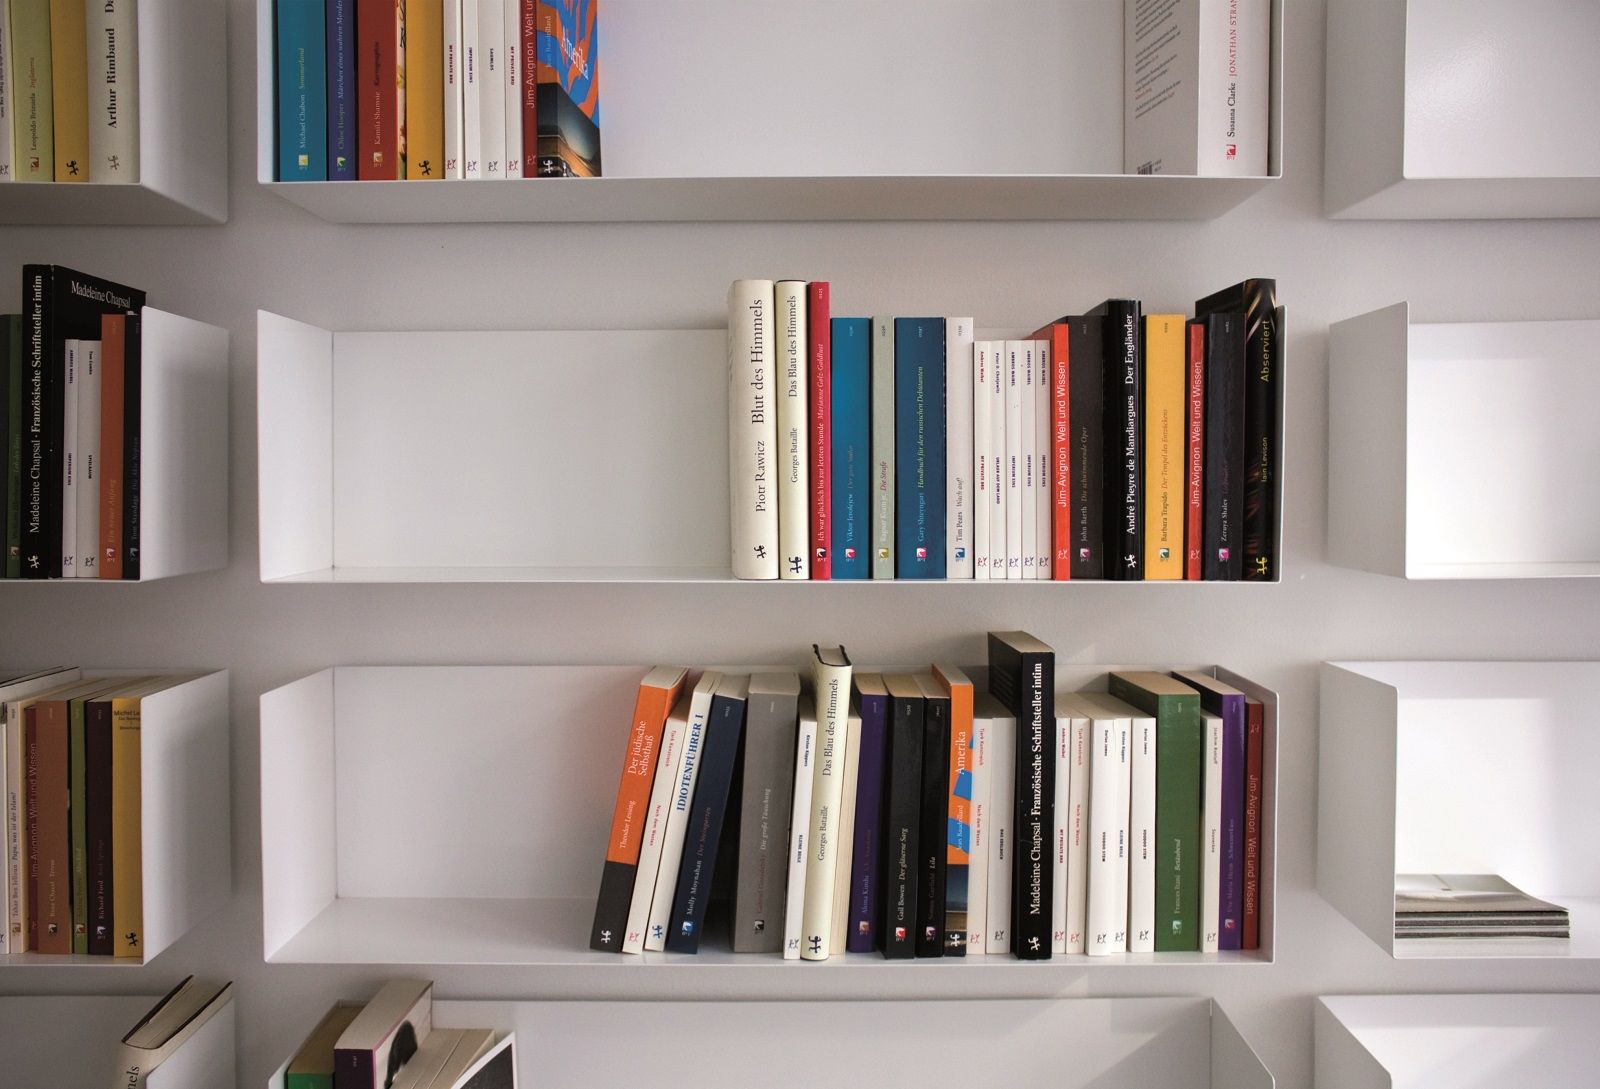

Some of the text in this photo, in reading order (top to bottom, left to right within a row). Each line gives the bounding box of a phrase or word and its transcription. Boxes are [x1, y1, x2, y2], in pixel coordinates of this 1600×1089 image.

[525, 13, 533, 36] Welt
[105, 28, 115, 84] Rimbaud
[449, 45, 453, 53] MY
[510, 46, 515, 54] MY
[1229, 29, 1237, 76] JONATHAN
[336, 70, 344, 99] Märchen
[526, 42, 536, 109] Jim-Avignon
[1227, 82, 1236, 106] Clarke
[106, 88, 117, 128] Arthur
[337, 103, 345, 128] Hooper
[1226, 108, 1236, 137] Susanna
[71, 280, 131, 309] Madeleine Chapsal
[787, 295, 797, 337] Himmels
[787, 340, 797, 355] des
[787, 357, 797, 378] Blau
[1261, 320, 1270, 383] Abserviert
[30, 275, 42, 533] Madeleine Chapsal Französische Schriftsteller intim
[749, 299, 766, 512] Piotr Rawicz Blut des Himmels
[788, 380, 797, 397] Das
[1057, 362, 1068, 507] Jim-Avignon Welt und Wissen
[1124, 314, 1136, 534] André Pieyre de Mandiargues Der Engländer
[1192, 362, 1202, 507] Jim-Avignon Welt und Wissen
[790, 455, 798, 483] Georges
[817, 490, 825, 517] glücklich
[627, 721, 647, 774] Der jüdische
[638, 735, 654, 776] Selbsthaß
[676, 724, 702, 811] IDIOTENFÜHRER
[955, 731, 966, 774] Amerika
[818, 679, 838, 861] Georges Bataille Das Blau des Himmels
[1030, 663, 1042, 914] Madeleine Chapsal Französische Schriftsteller intim
[619, 801, 635, 849] Theodor Lessing
[654, 805, 662, 816] Nach
[899, 843, 908, 867] gläserne
[900, 828, 908, 842] Sarg
[1247, 774, 1257, 914] Jim-Avignon Welt und Wissen
[686, 860, 702, 915] Molly Moynahan
[898, 868, 906, 880] Der
